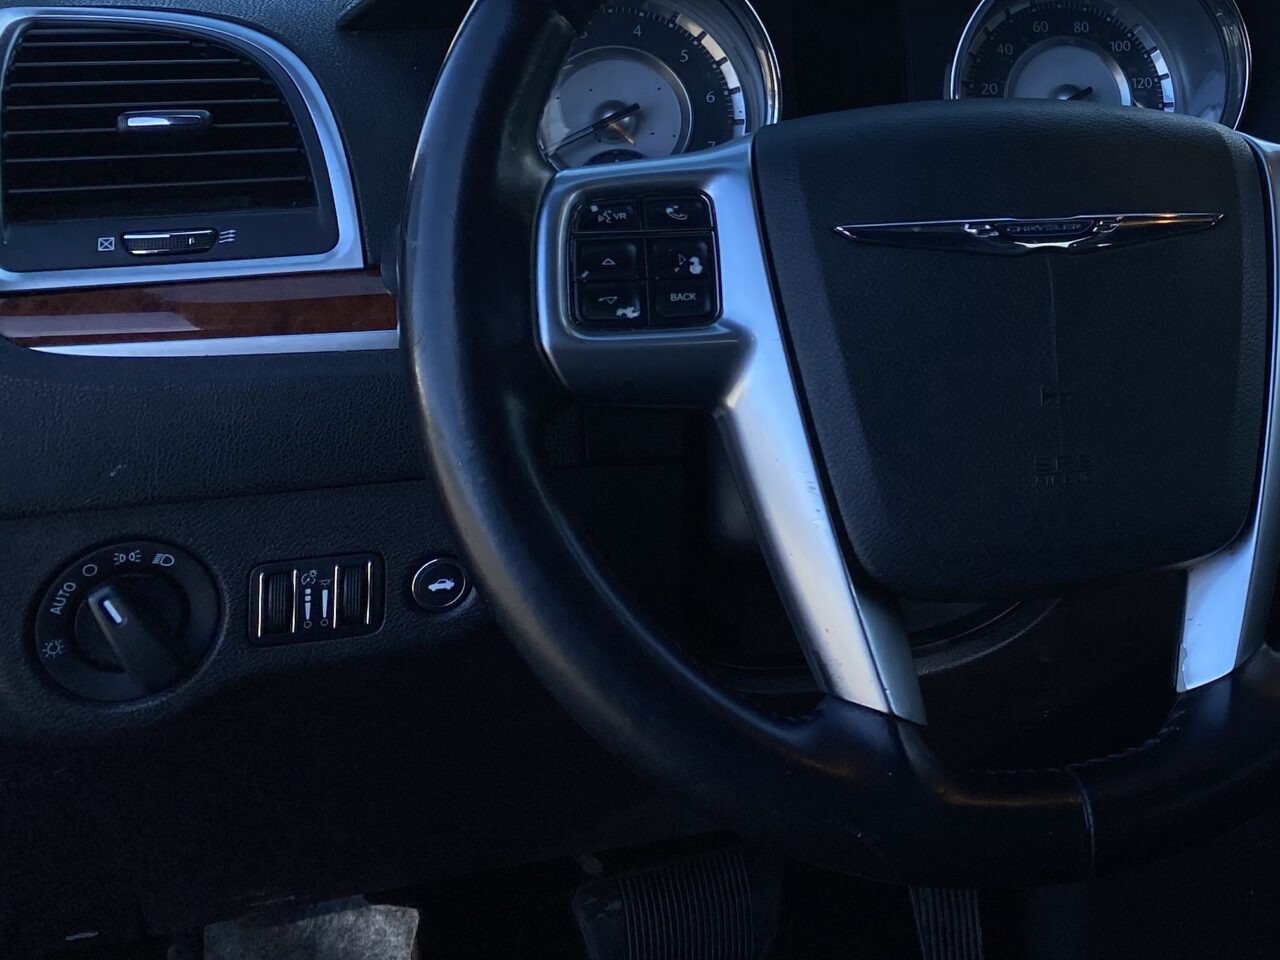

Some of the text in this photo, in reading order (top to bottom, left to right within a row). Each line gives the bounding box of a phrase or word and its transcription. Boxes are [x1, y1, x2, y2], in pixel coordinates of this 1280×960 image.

[633, 24, 642, 37] 4
[1032, 21, 1049, 33] 60
[1073, 21, 1089, 33] 80
[996, 43, 1013, 56] 40
[1110, 40, 1131, 52] 100
[679, 49, 689, 63] 5
[981, 83, 998, 95] 20
[1132, 77, 1153, 89] 120
[706, 90, 716, 104] 6
[612, 212, 627, 220] VR
[670, 292, 697, 302] BACK
[49, 581, 76, 615] AUTO
